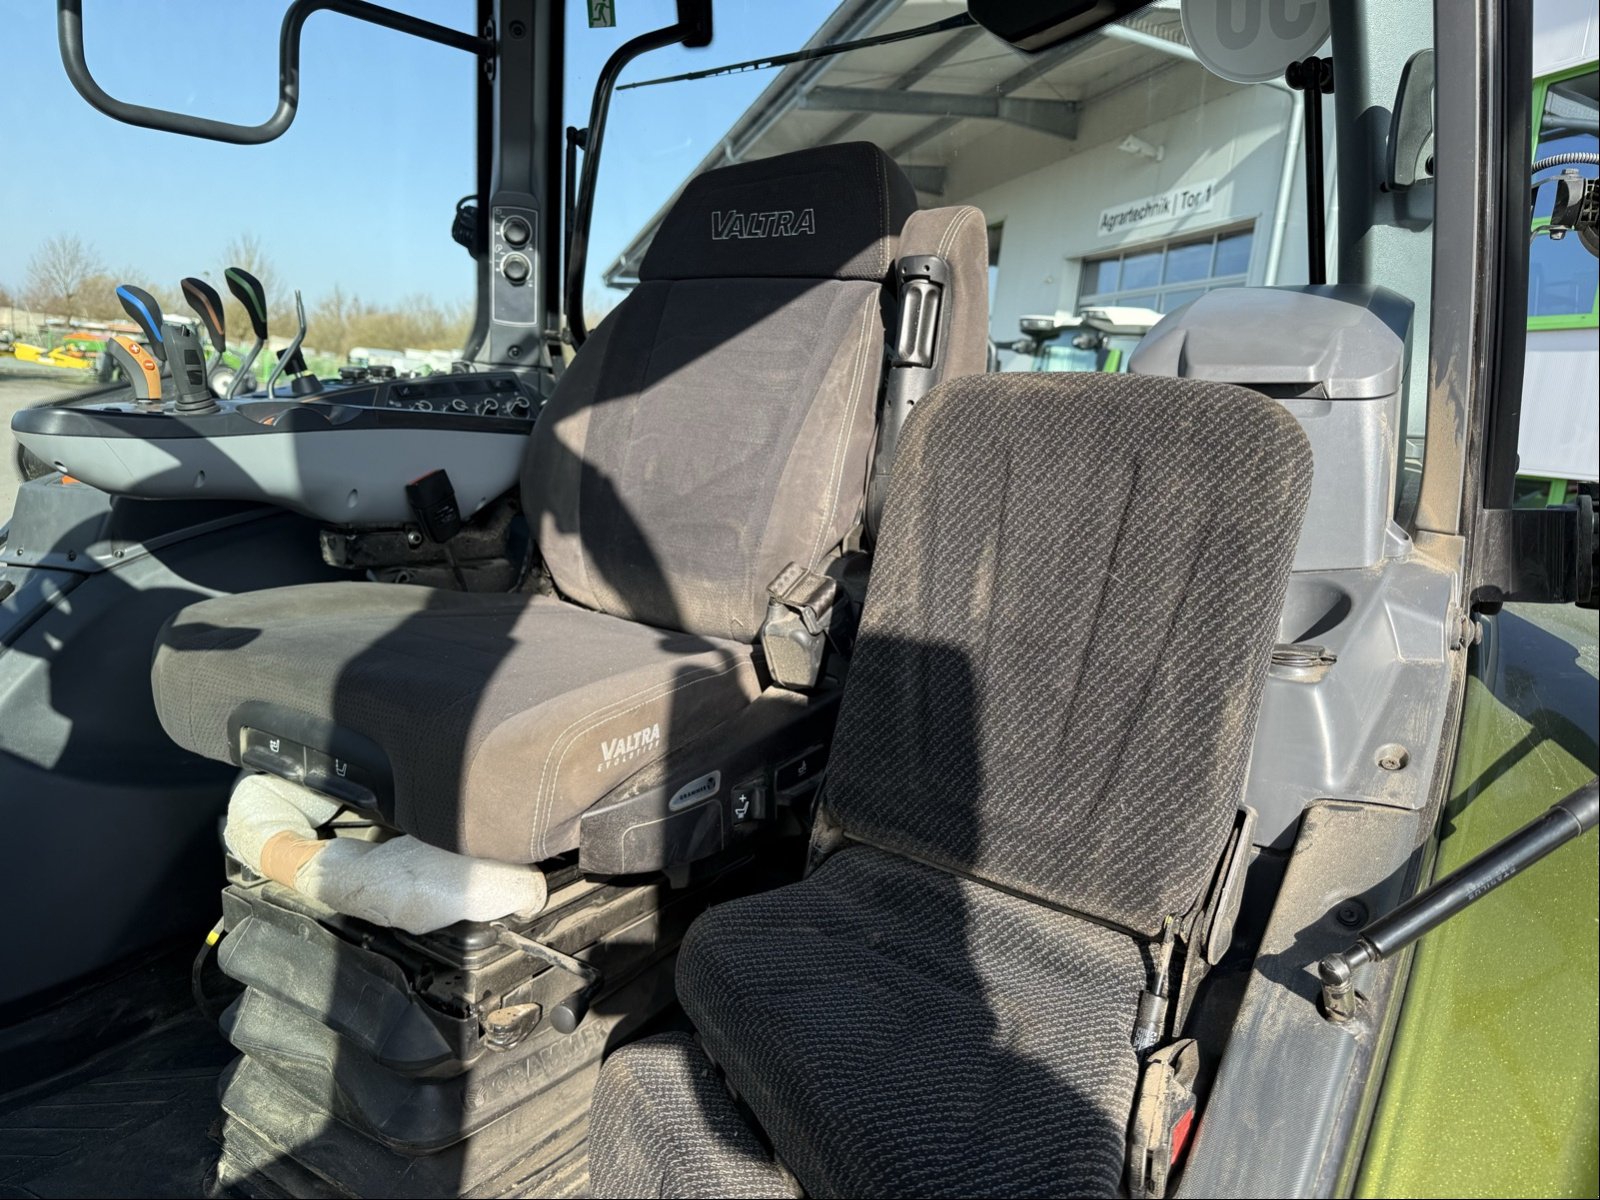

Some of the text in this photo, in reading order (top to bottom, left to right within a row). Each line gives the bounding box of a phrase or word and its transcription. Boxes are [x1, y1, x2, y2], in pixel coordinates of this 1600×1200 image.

[711, 207, 816, 241] VALTRA
[1099, 196, 1171, 233] Agrartechnik
[1180, 190, 1202, 210] Tor
[600, 722, 660, 761] VALTRA
